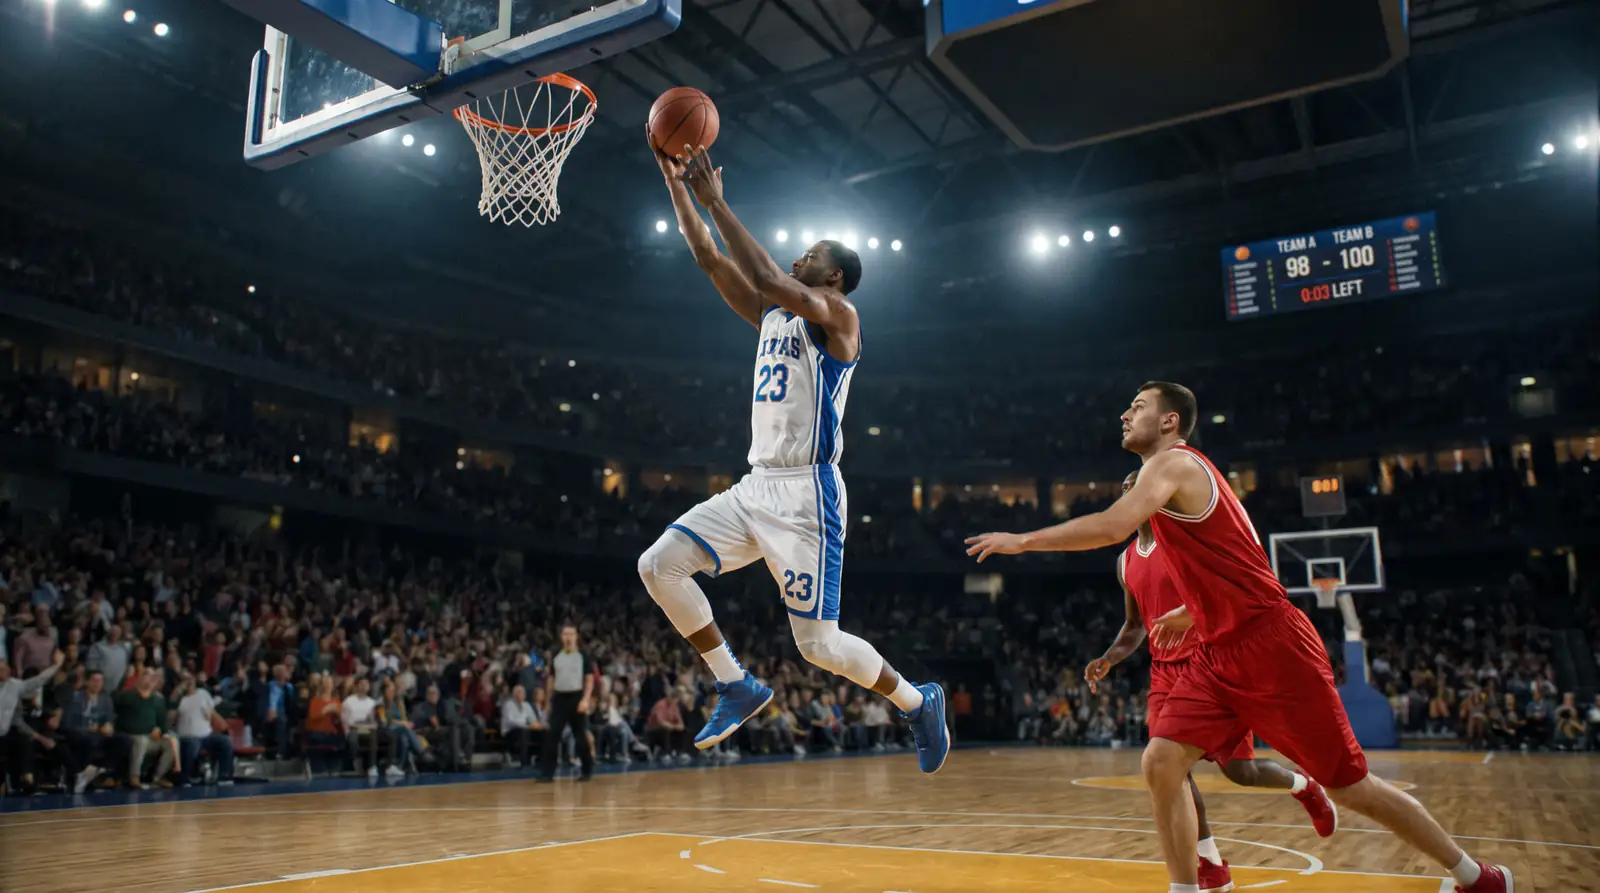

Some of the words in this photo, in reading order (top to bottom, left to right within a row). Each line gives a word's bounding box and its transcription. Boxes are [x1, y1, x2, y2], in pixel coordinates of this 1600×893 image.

[1277, 238, 1307, 253] TEAM
[1308, 236, 1317, 248] A
[1333, 227, 1363, 244] TEAM
[1365, 225, 1374, 239] B
[1285, 256, 1310, 278] 98
[1340, 245, 1375, 270] 100
[1301, 284, 1330, 303] 0:03
[1332, 279, 1363, 298] LEFT
[755, 363, 788, 402] 23
[784, 569, 813, 601] 23
